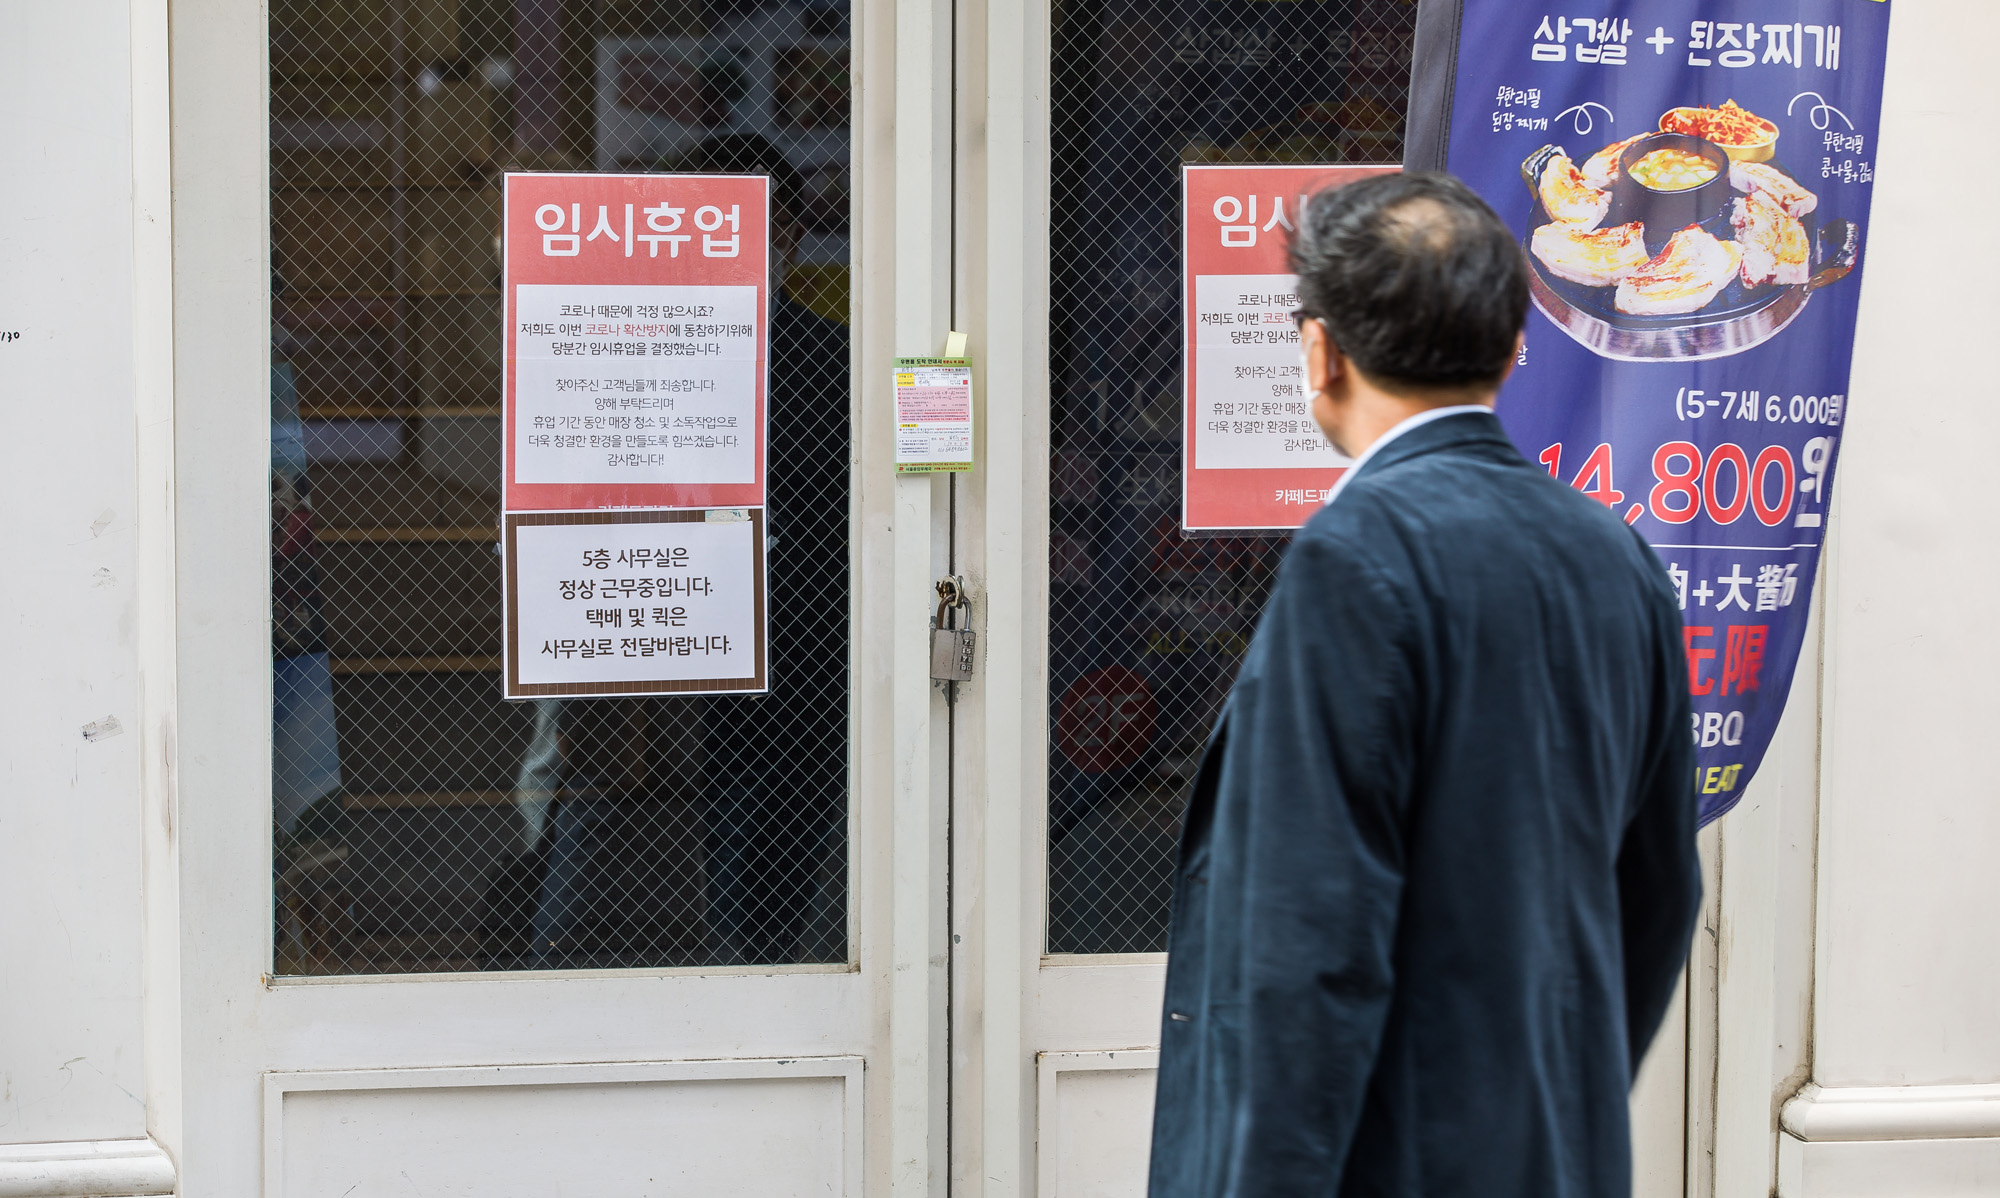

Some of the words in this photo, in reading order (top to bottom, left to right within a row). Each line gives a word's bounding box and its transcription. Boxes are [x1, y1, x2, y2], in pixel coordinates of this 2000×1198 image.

[1531, 15, 1633, 65] 삼겹살
[1687, 20, 1842, 71] 된장찌개
[1496, 86, 1540, 108] 무한리필
[1823, 131, 1863, 154] 무한리필
[534, 201, 740, 258] 임시휴업
[1238, 294, 1271, 306] 코로나
[560, 305, 594, 318] 코로나
[598, 305, 633, 318] 때문에
[636, 305, 659, 318] 걱정
[662, 305, 714, 318] 많으시죠?
[1201, 313, 1234, 325] 저희도
[1238, 313, 1259, 325] 이번
[521, 323, 555, 336] 저희도
[559, 323, 582, 336] 이번
[585, 323, 620, 336] 코로나
[623, 323, 681, 337] 확산방지에
[684, 323, 752, 337] 동참하기위해
[1231, 330, 1264, 344] 당분간
[551, 343, 587, 356] 당분간
[590, 343, 647, 356] 임시휴업을
[651, 342, 722, 356] 결정했습니다.
[1234, 366, 1276, 379] 찾아주신
[556, 379, 599, 392] 찾아주신
[602, 379, 657, 392] 고객님들께
[660, 379, 716, 392] 죄송합니다.
[1272, 384, 1293, 396] 양해
[595, 398, 617, 410] 양해
[620, 398, 674, 410] 부탁드리며
[1213, 402, 1234, 415] 휴업
[1237, 402, 1259, 415] 기간
[1261, 402, 1282, 415] 동안
[1285, 402, 1306, 414] 매장
[1675, 387, 1759, 422] (5-7세
[533, 416, 555, 429] 휴업
[559, 416, 580, 428] 기간
[584, 416, 606, 428] 동안
[608, 416, 631, 428] 매장
[634, 416, 655, 428] 청소
[659, 416, 670, 428] 및
[672, 416, 738, 428] 소독작업으로
[1208, 421, 1230, 433] 더욱
[1232, 421, 1264, 434] 청결한
[1267, 420, 1298, 434] 환경을
[528, 434, 550, 448] 더욱
[554, 434, 586, 448] 청결한
[590, 434, 621, 448] 환경을
[626, 434, 669, 448] 만들도록
[672, 434, 738, 448] 힘쓰겠습니다.
[608, 454, 664, 466] 감사합니다!
[583, 548, 611, 569] 5층
[616, 547, 690, 568] 사무실은
[559, 580, 596, 600] 정상
[600, 576, 713, 598] 근무중입니다.
[586, 608, 622, 628] 택배
[628, 608, 645, 628] 및
[652, 606, 688, 627] 퀵은
[542, 638, 614, 659] 사무실로
[620, 635, 732, 658] 전달바랍니다.
